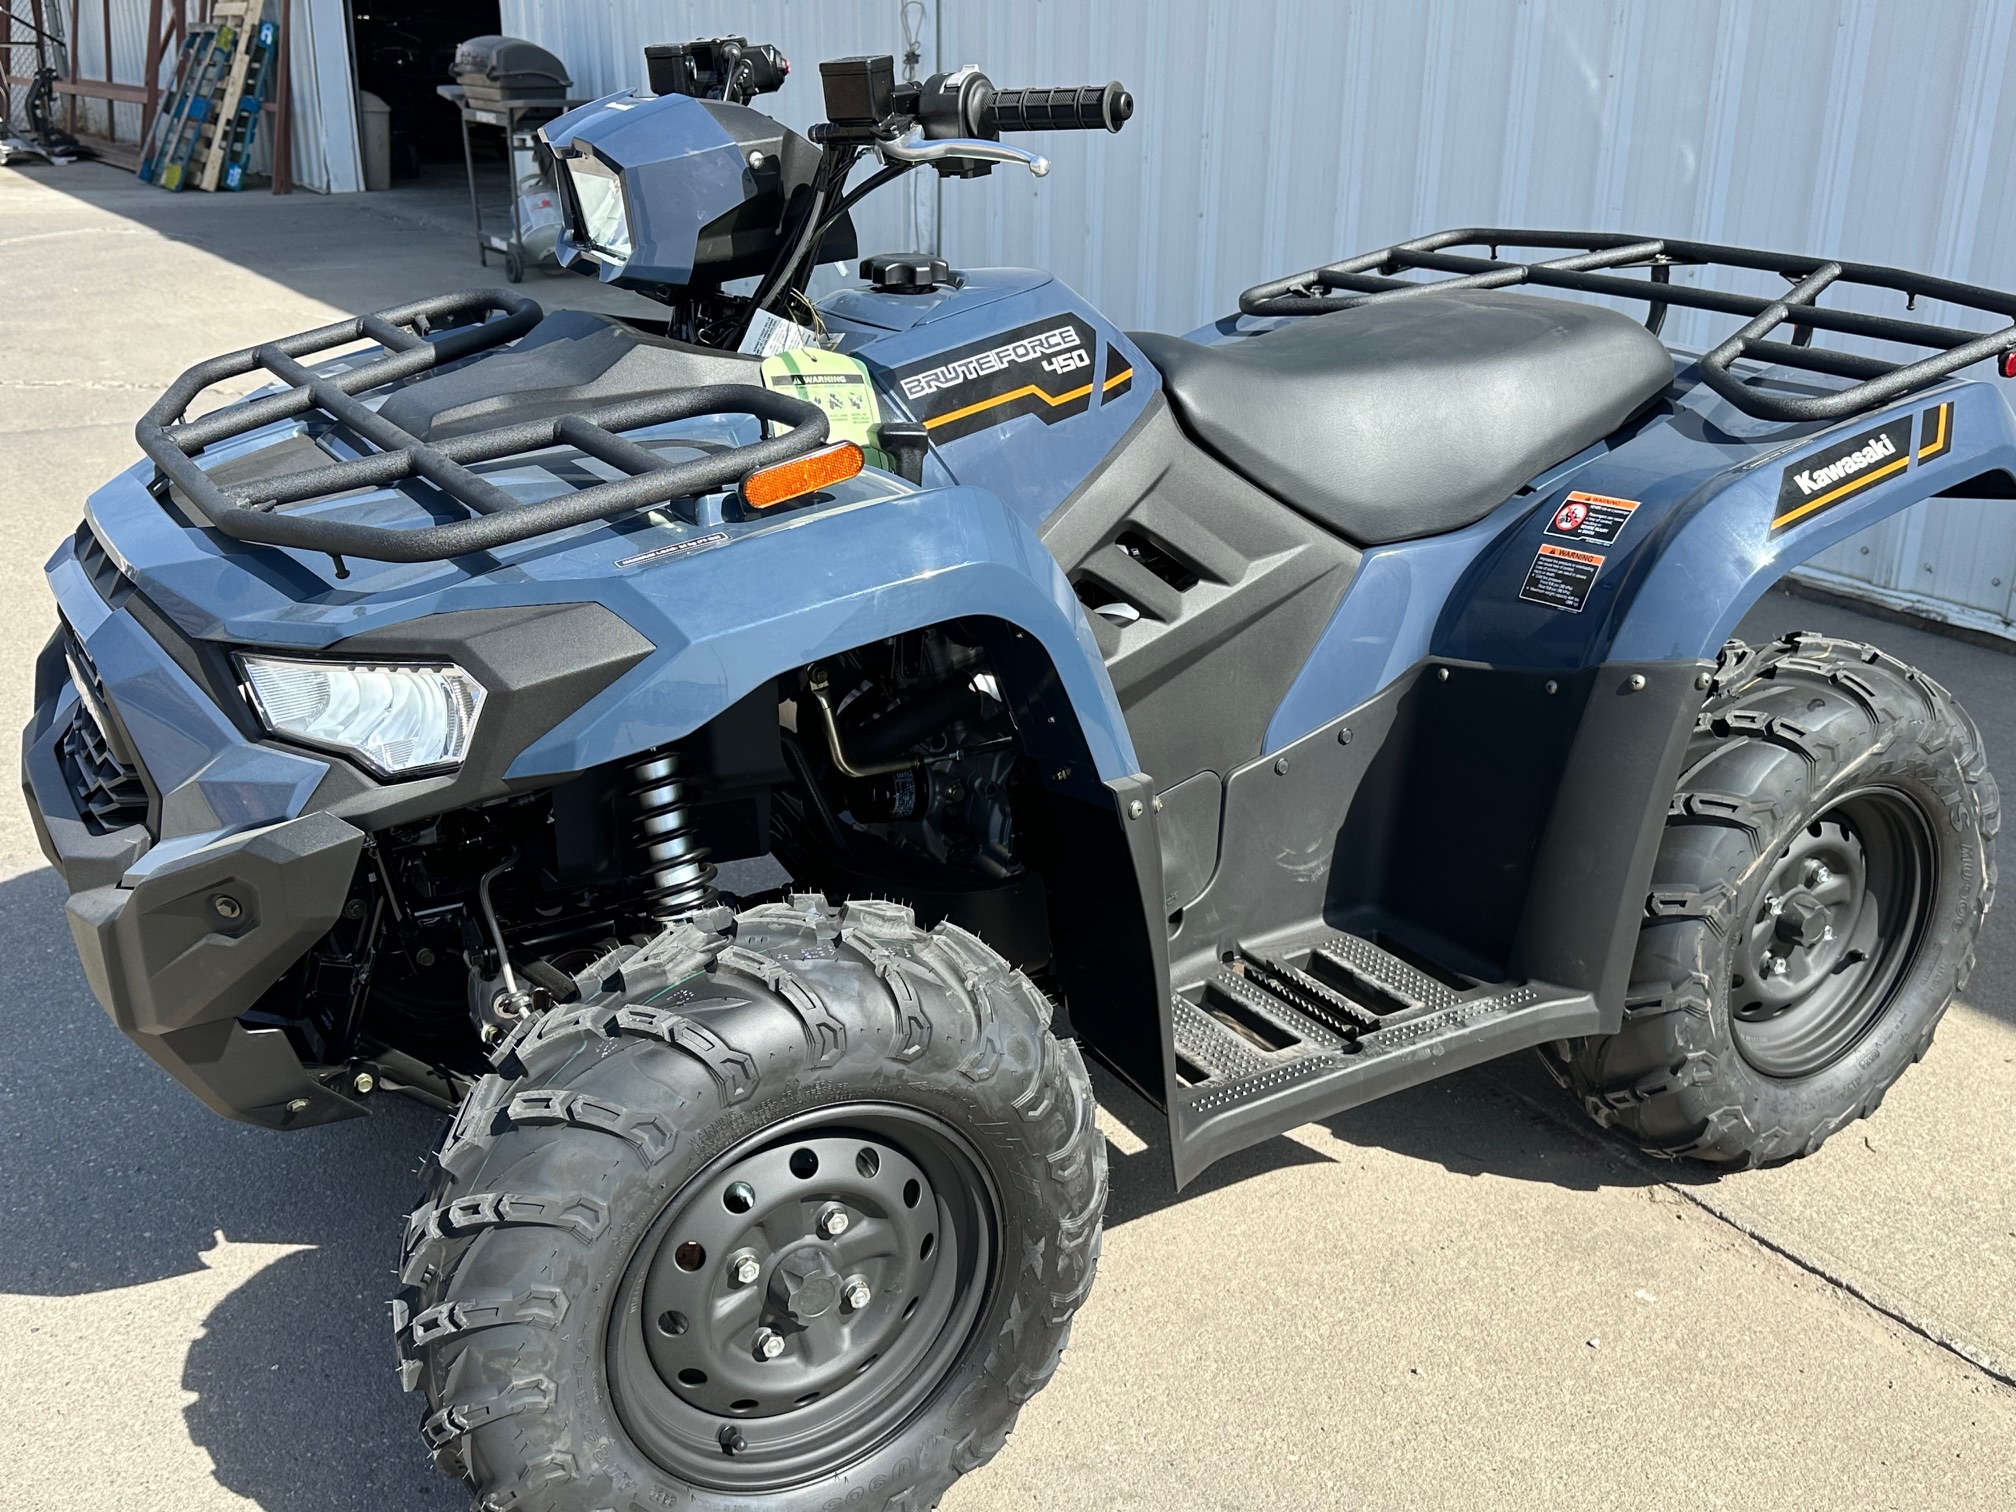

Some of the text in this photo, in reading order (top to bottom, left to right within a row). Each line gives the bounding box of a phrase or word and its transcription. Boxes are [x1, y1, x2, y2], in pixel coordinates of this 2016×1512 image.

[1041, 348, 1090, 375] 450
[804, 375, 846, 384] WARNING
[1793, 432, 1897, 496] Kawasaki
[1592, 497, 1621, 505] WARNING
[1558, 549, 1594, 562] WARNING
